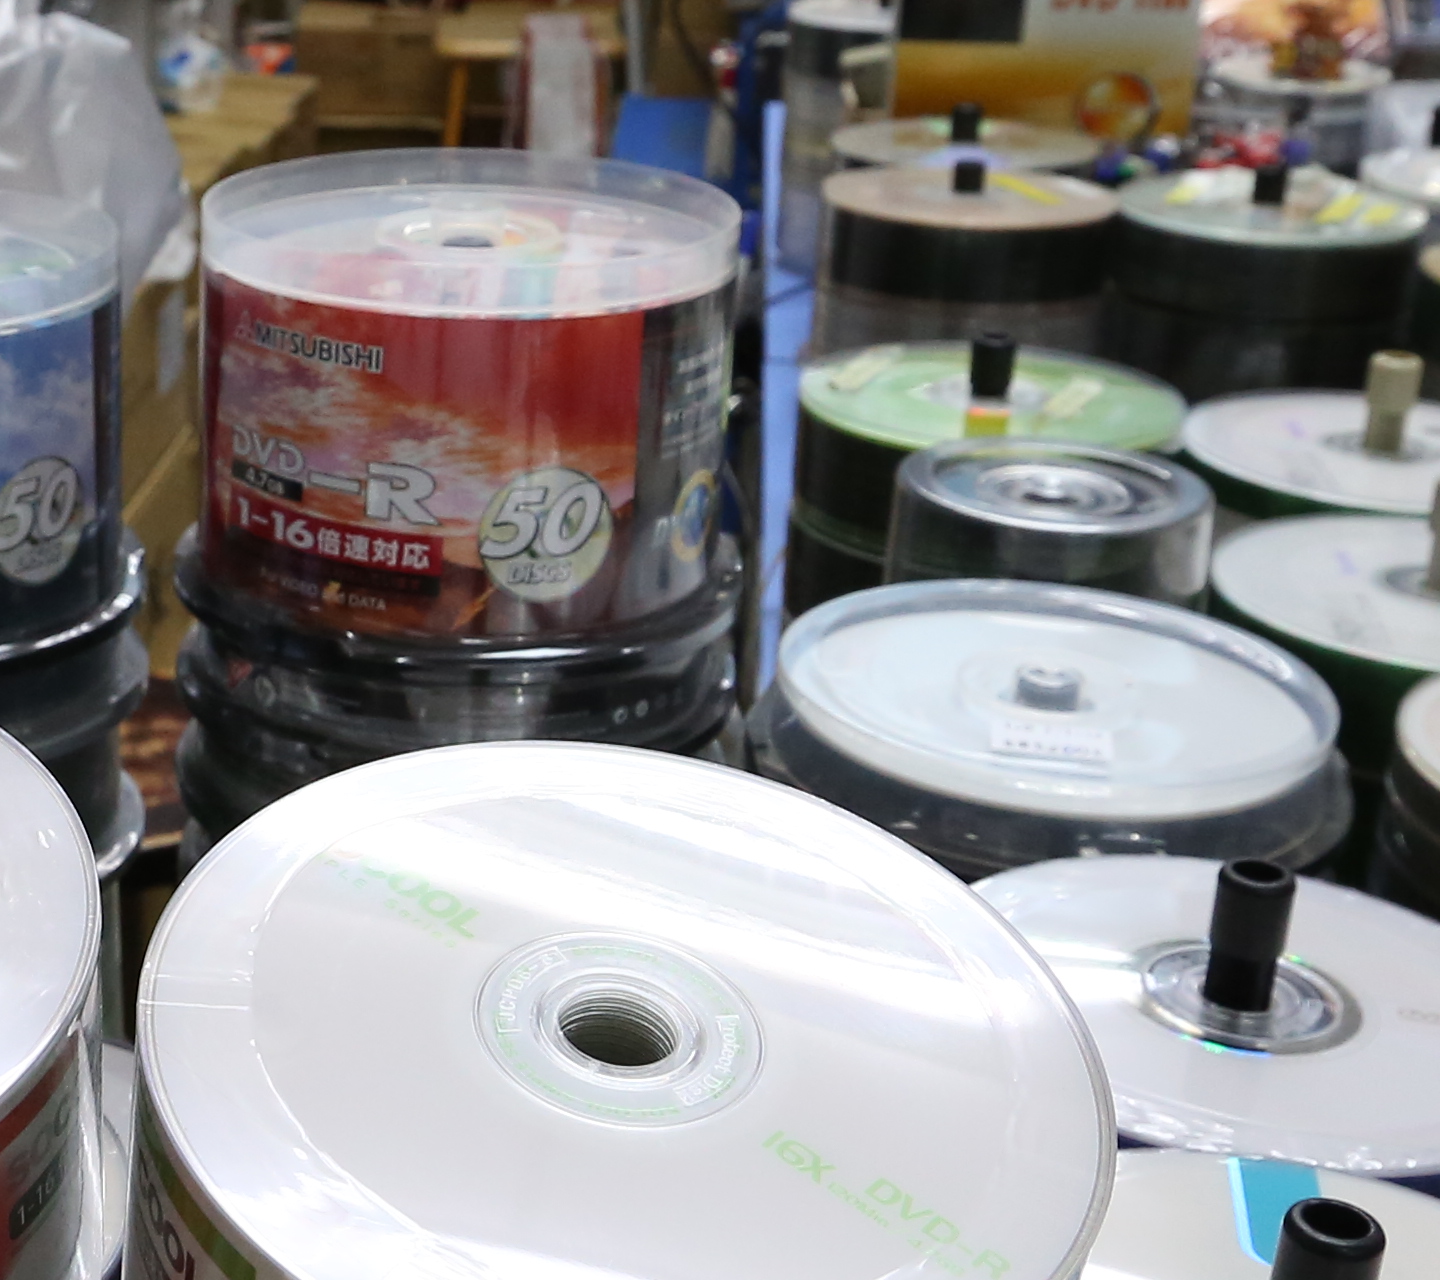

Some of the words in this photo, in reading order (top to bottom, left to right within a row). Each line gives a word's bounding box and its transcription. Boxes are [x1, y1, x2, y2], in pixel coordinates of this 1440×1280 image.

[255, 322, 384, 374] MITSUBISHI
[480, 478, 605, 561] 50
[761, 1130, 838, 1185] 16X
